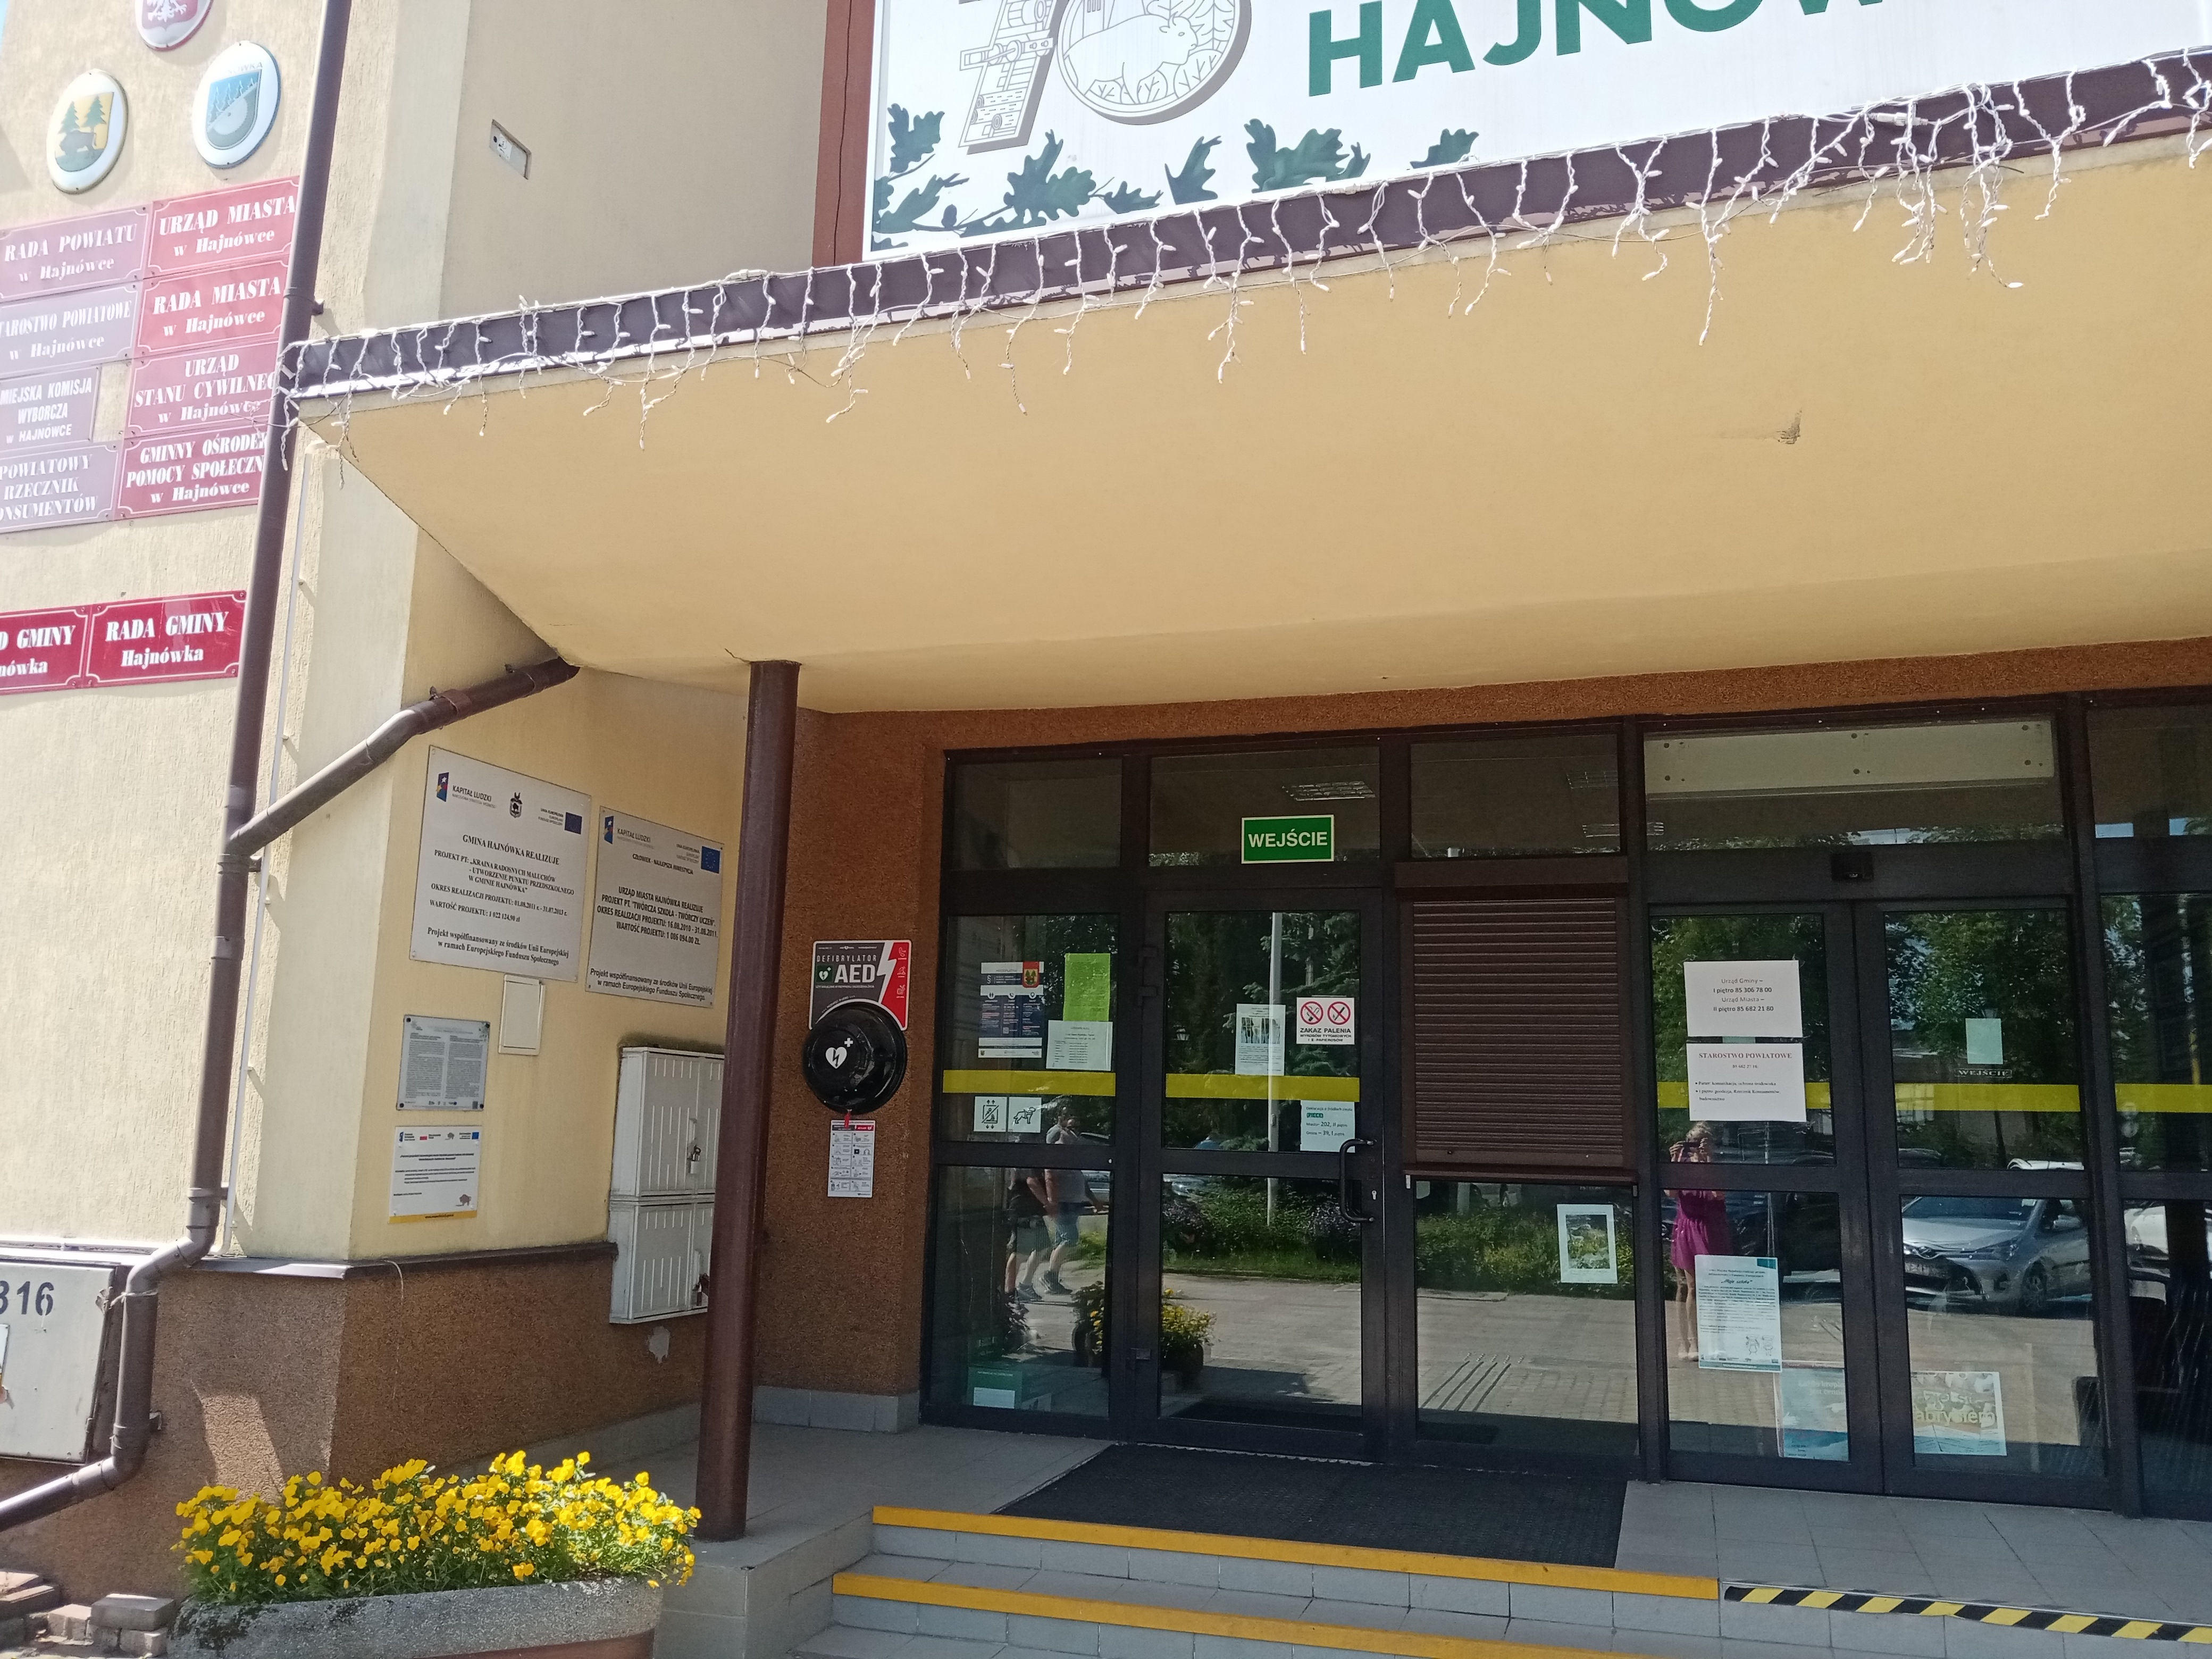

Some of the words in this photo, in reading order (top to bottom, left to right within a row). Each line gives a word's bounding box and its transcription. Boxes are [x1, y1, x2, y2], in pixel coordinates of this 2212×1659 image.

[1309, 0, 1883, 97] HAJN
[160, 209, 218, 236] URZĄD
[227, 195, 295, 224] MIASTA
[5, 239, 48, 262] RADA
[59, 223, 137, 253] POWIATU
[174, 245, 187, 256] w
[195, 230, 275, 254] Hajnówce
[19, 271, 31, 282] w
[40, 258, 114, 281] Hajnówce
[153, 290, 202, 315] RADA
[211, 276, 281, 305] MIASTA
[62, 300, 131, 328] POWIATOWE
[163, 325, 177, 336] w
[185, 311, 265, 334] Hajnówce
[10, 349, 21, 360] w
[30, 336, 105, 358] Hajnówce
[185, 354, 239, 377] URZĄD
[0, 385, 42, 405] MIEJSKA
[47, 378, 92, 398] KOMISJA
[134, 384, 186, 408] STANU
[194, 372, 275, 399] CYWILNEG
[18, 403, 68, 424] WYBORCZA
[158, 412, 171, 423] w
[19, 423, 72, 442] HAJNÓWCE
[140, 441, 196, 464] GMINNY
[0, 454, 92, 479] POWIATOWY
[126, 465, 185, 488] POMOCY
[191, 455, 265, 480] SPOŁECZN
[4, 477, 79, 500] RZECZNIK
[151, 492, 164, 503] w
[172, 482, 250, 501] Hajnówce
[16, 625, 76, 649] GMINY
[105, 618, 155, 641] RADA
[165, 611, 229, 636] GMINY
[120, 645, 204, 669] Hajnówka
[453, 785, 473, 797] KAPITAŁ
[474, 791, 492, 802] LUDZKI
[463, 834, 486, 848] GMINA
[488, 840, 524, 857] HAJNÓWKA
[526, 850, 559, 865] REALIZUJE
[1248, 828, 1327, 848] WEJŚCIE
[434, 849, 459, 861] PROJEKT
[494, 863, 526, 876] RADOSNYCH
[526, 870, 556, 882] MALUCHÓW
[431, 883, 450, 892] OKRES
[451, 887, 483, 899] REALIZACJI
[473, 867, 507, 881] UTWORZENIE
[509, 875, 529, 885] PUNKTU
[530, 880, 574, 895] PRZEDSZKOLNEGO
[475, 877, 495, 886] GMINIE
[430, 899, 457, 910] WARTOŚĆ
[602, 894, 623, 906] PROJEKT
[618, 886, 635, 898] URZĄD
[636, 890, 653, 901] MIASTA
[655, 895, 681, 907] HAJNÓWKA
[597, 905, 614, 915] OKRES
[614, 909, 641, 921] REALIZACJI
[616, 921, 640, 933] WARTOŚĆ
[428, 927, 448, 937] Projekt
[450, 932, 499, 946] współfinansowany
[506, 940, 527, 950] środków
[540, 945, 569, 959] Europejskiej
[444, 942, 465, 951] ramach
[466, 944, 504, 958] Europejskiego
[505, 950, 530, 960] Funduszu
[531, 954, 559, 967] Społecznego
[590, 968, 608, 978] Projekt
[834, 964, 875, 983] AED
